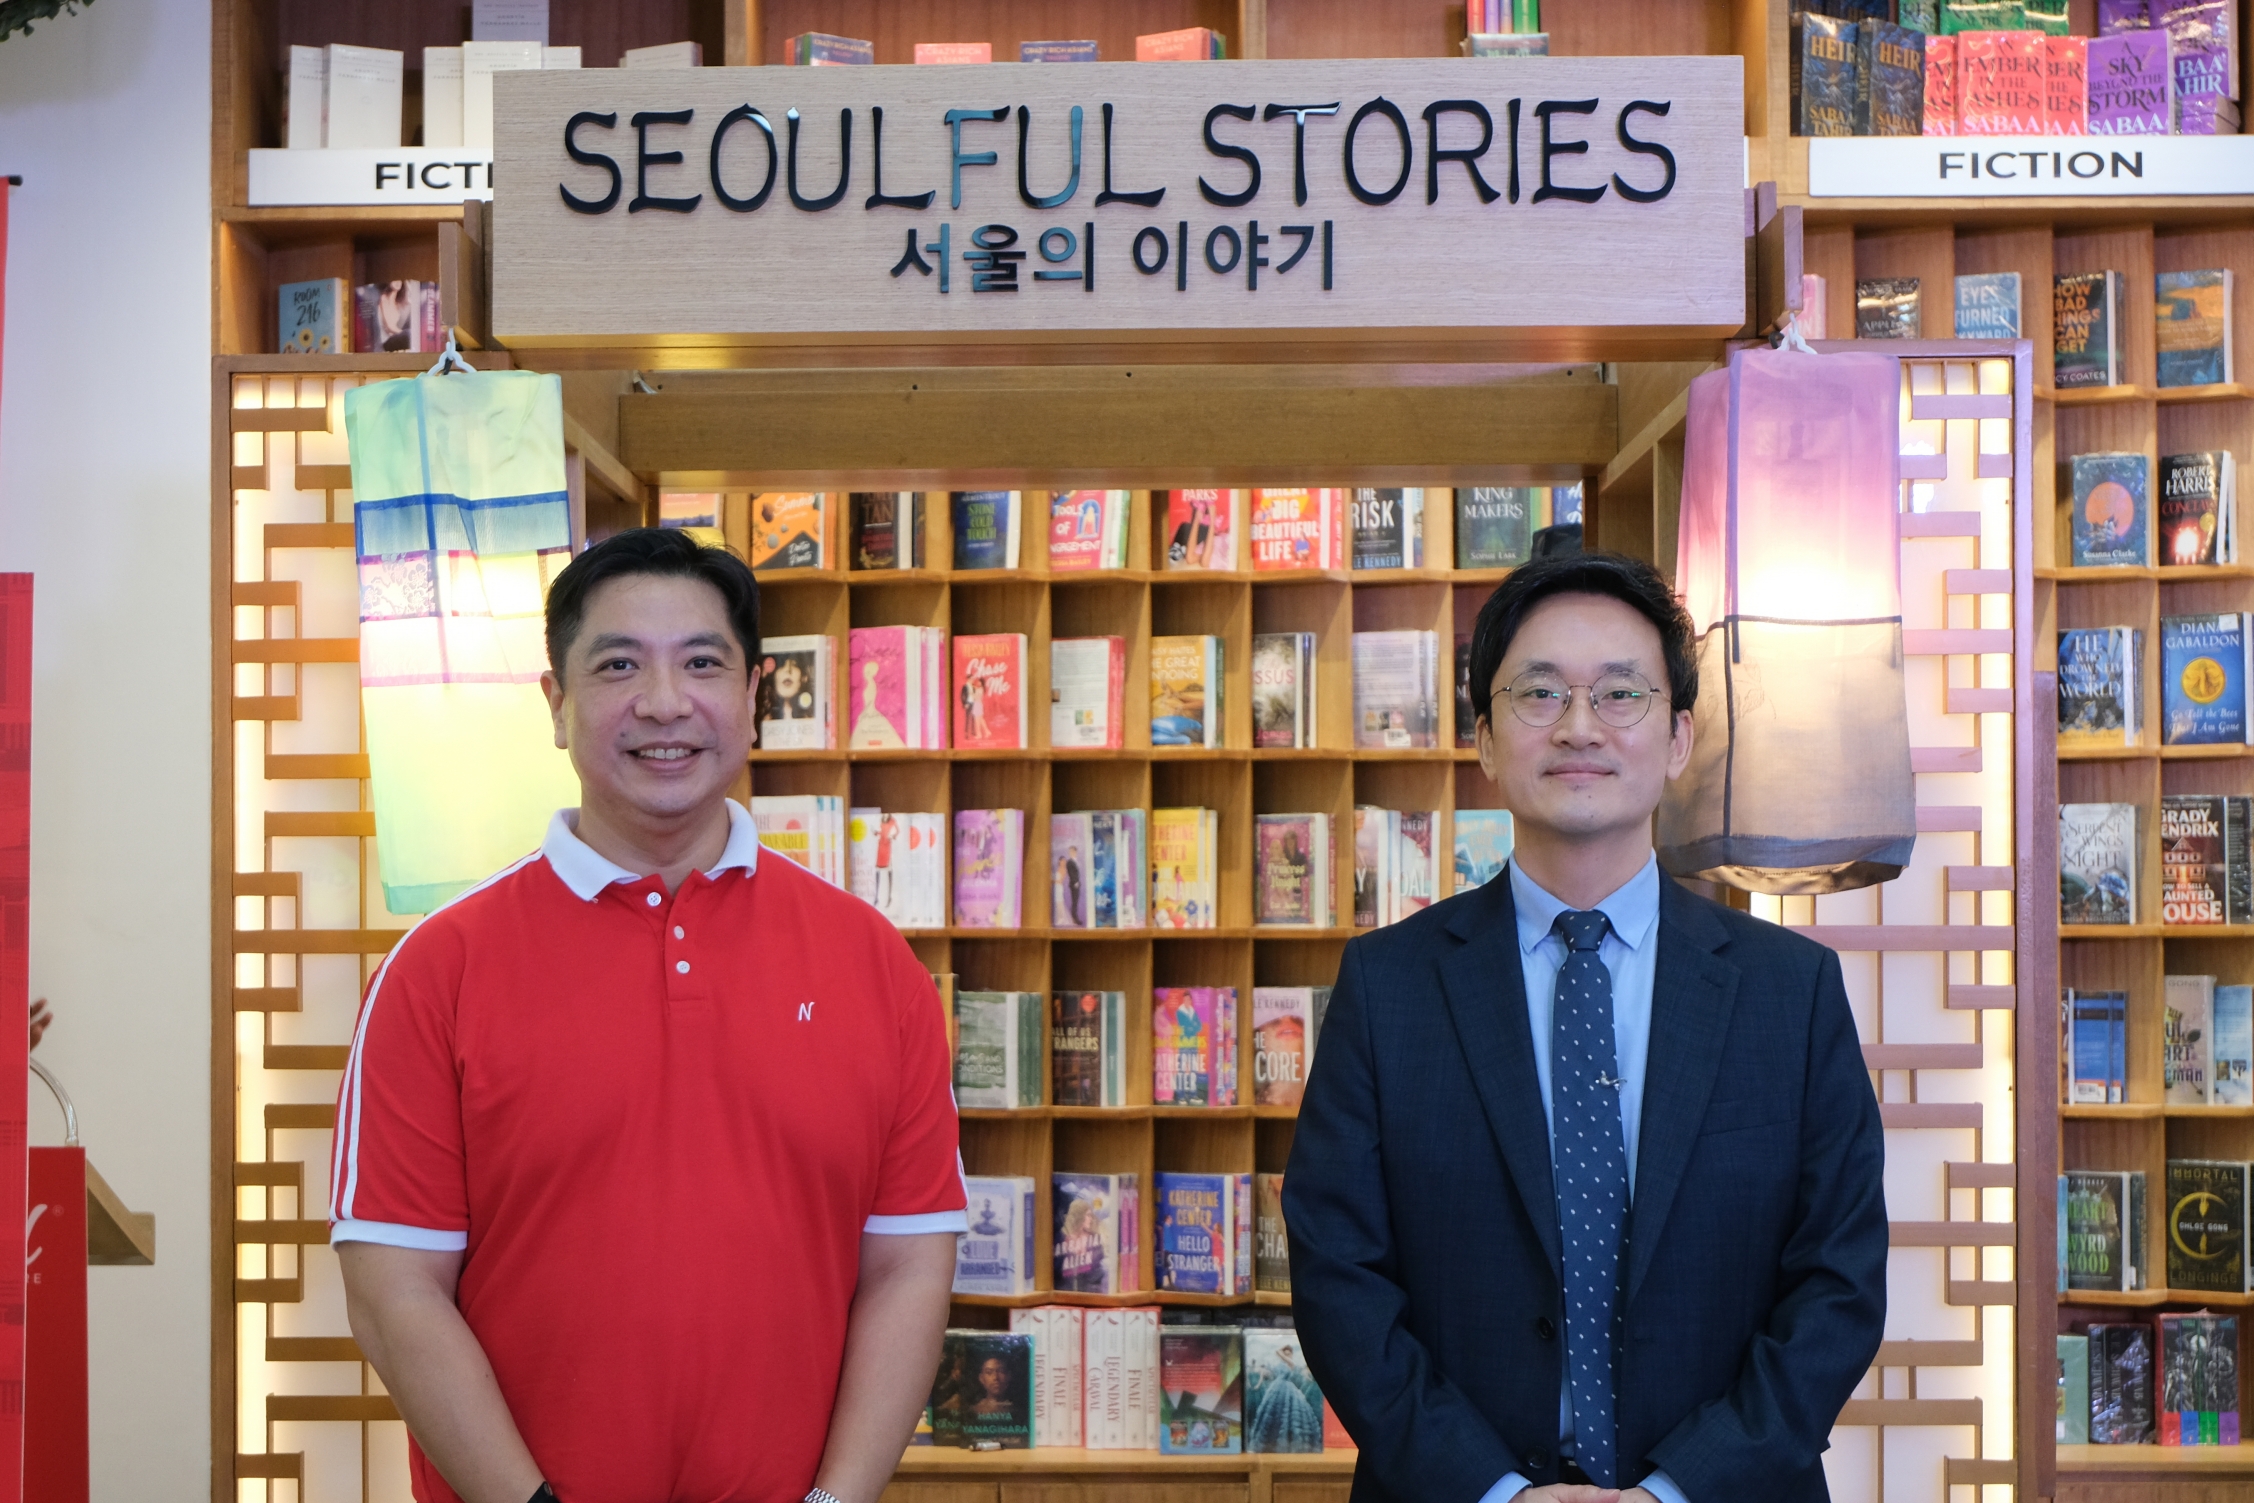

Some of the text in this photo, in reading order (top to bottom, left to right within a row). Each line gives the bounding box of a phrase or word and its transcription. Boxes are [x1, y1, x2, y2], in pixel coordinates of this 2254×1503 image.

[1880, 41, 1921, 80] HEIR
[2109, 54, 2143, 79] SKY
[2088, 86, 2166, 115] STORM
[1964, 115, 2041, 134] SABAA
[2088, 113, 2164, 135] SABAA
[559, 95, 1678, 215] SEOULFUL STORIES
[1939, 151, 2143, 179] FICTION
[890, 220, 1333, 294] 서울의 이야기
[293, 287, 321, 305] ROOM
[2055, 297, 2088, 311] BAD
[2056, 339, 2088, 354] GET
[1271, 499, 1300, 520] BIG
[1351, 500, 1395, 530] RISK
[1464, 503, 1524, 519] MAKERS
[1251, 520, 1320, 540] BEAUTIFUL
[1259, 541, 1293, 561] LIFE
[2165, 634, 2240, 648] GABALDON
[966, 658, 1008, 679] Chase
[1165, 655, 1201, 667] GREAT
[985, 676, 1011, 697] Me
[2059, 681, 2122, 698] WORLD
[2080, 835, 2124, 847] WINGS
[2063, 846, 2123, 868] NIGHT
[2163, 900, 2223, 922] OUSE
[1168, 1190, 1219, 1207] KATHERINE
[1176, 1208, 1212, 1226] CENTER
[2207, 1221, 2229, 1232] GONG
[1177, 1235, 1211, 1251] HELLO
[1167, 1254, 1220, 1272] STRANGER
[1053, 1367, 1067, 1408] FINALE
[1088, 1366, 1104, 1411] CARAVAL
[1104, 1356, 1121, 1422] LEGENDARY
[1127, 1368, 1142, 1410] FINALE
[977, 1411, 1013, 1421] HANYA
[962, 1424, 1029, 1434] YANAGIHARA
